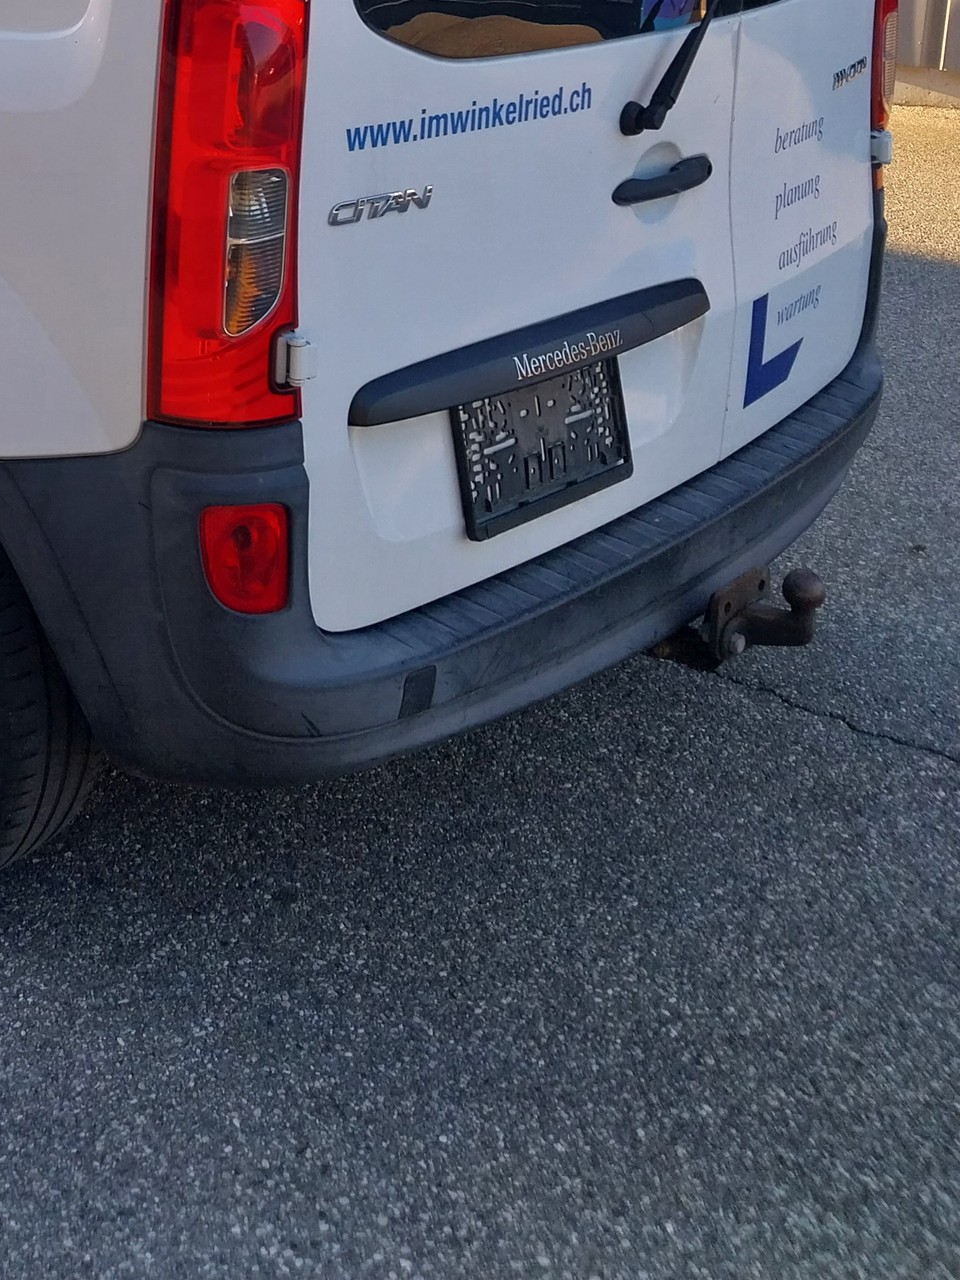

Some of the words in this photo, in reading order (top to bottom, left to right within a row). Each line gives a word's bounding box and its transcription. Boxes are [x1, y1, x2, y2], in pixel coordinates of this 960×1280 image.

[345, 82, 593, 152] www.imwinkelried.ch
[774, 116, 825, 155] beratung
[327, 184, 434, 227] CITAN
[774, 173, 821, 221] planung
[777, 220, 838, 271] ausführung
[776, 283, 822, 327] wartung
[512, 328, 624, 381] Mercedes-Benz
